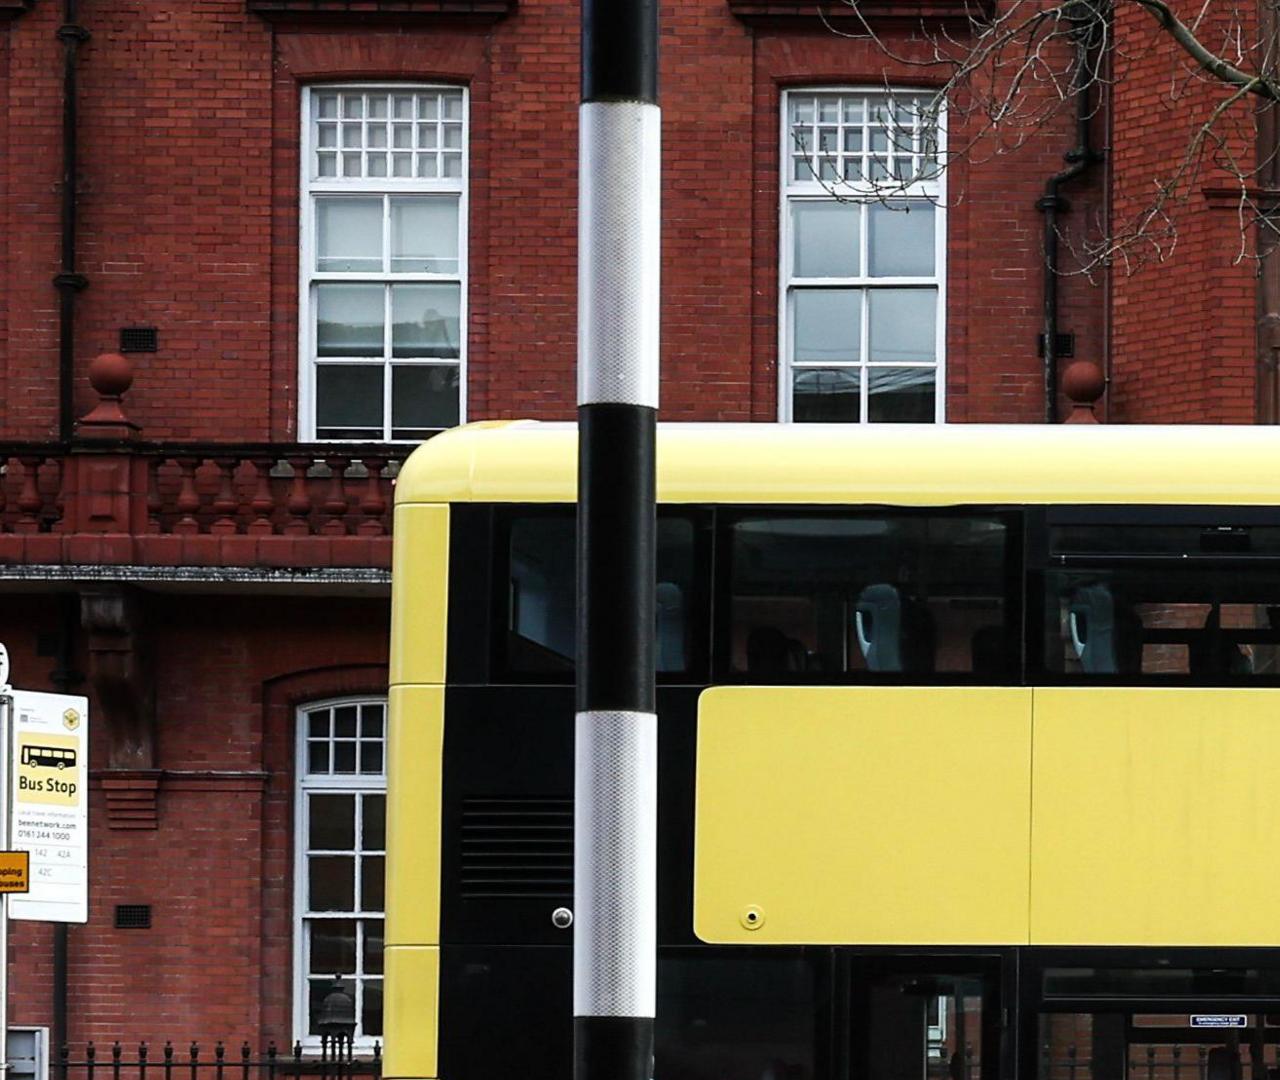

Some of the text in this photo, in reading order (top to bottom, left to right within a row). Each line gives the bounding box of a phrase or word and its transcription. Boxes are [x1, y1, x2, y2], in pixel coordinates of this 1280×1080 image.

[19, 775, 77, 797] Bus Stop
[18, 819, 77, 829] beenetwork.com
